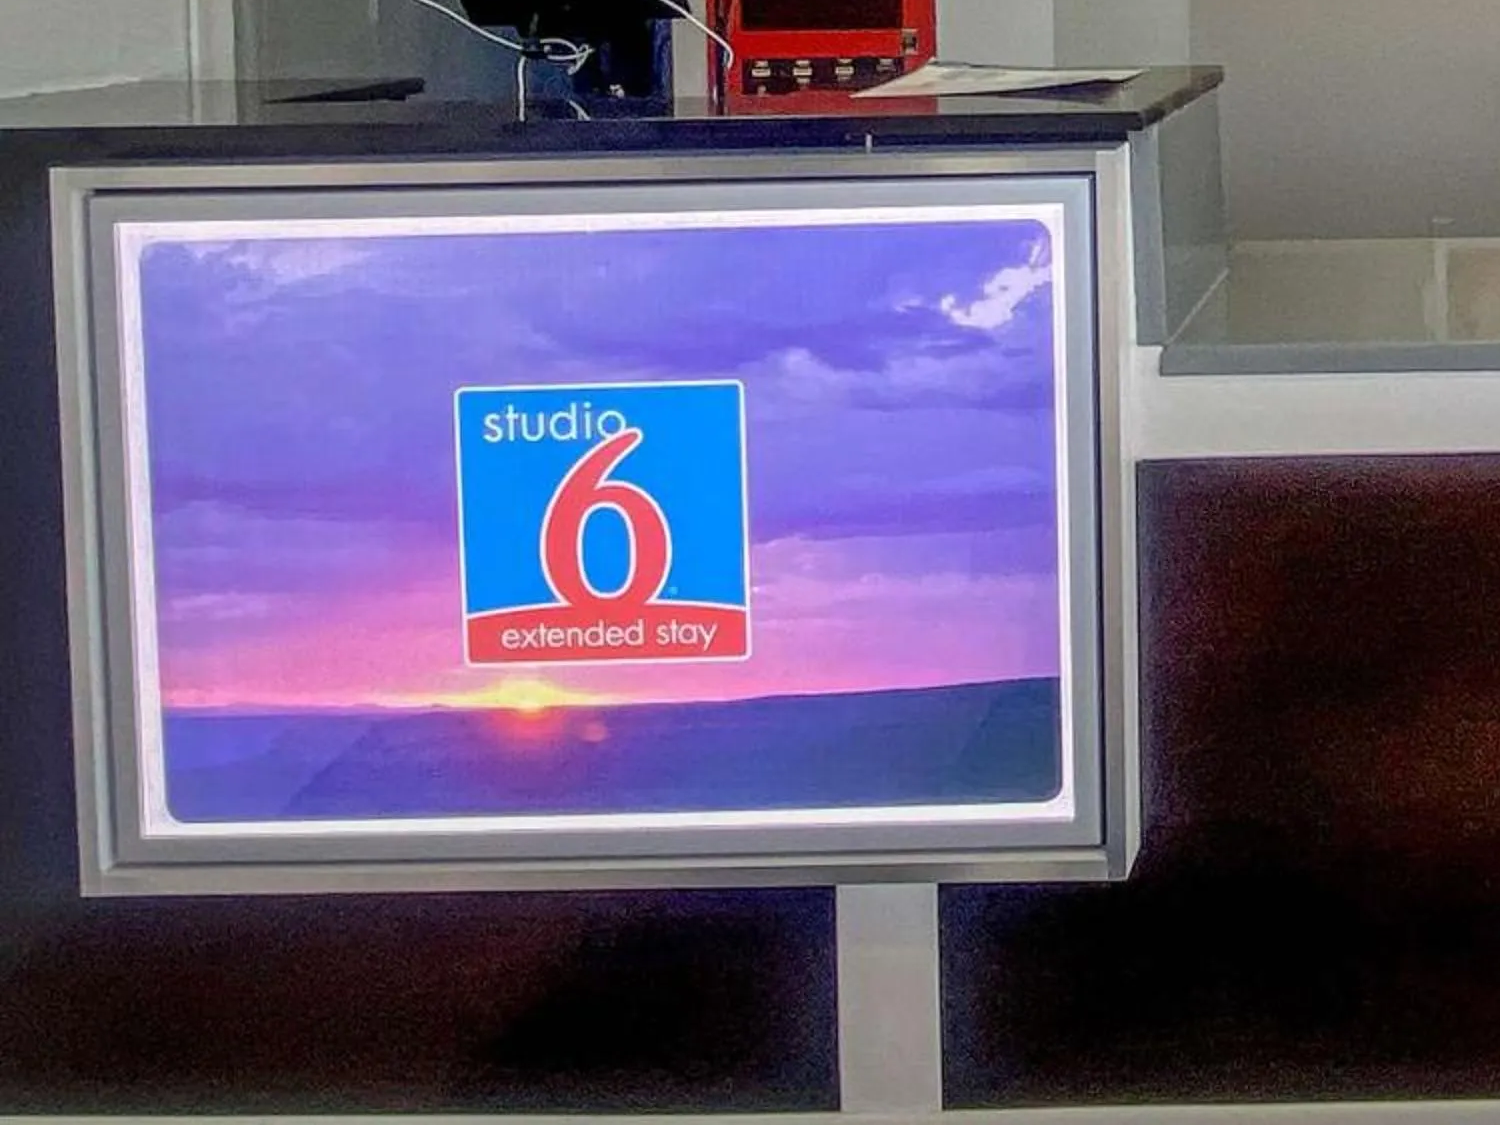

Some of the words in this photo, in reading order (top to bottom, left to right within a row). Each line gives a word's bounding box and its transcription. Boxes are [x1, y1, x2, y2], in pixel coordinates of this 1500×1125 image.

[484, 402, 627, 443] studio
[540, 427, 673, 610] 6
[501, 618, 644, 649] extended
[655, 619, 718, 651] stay
